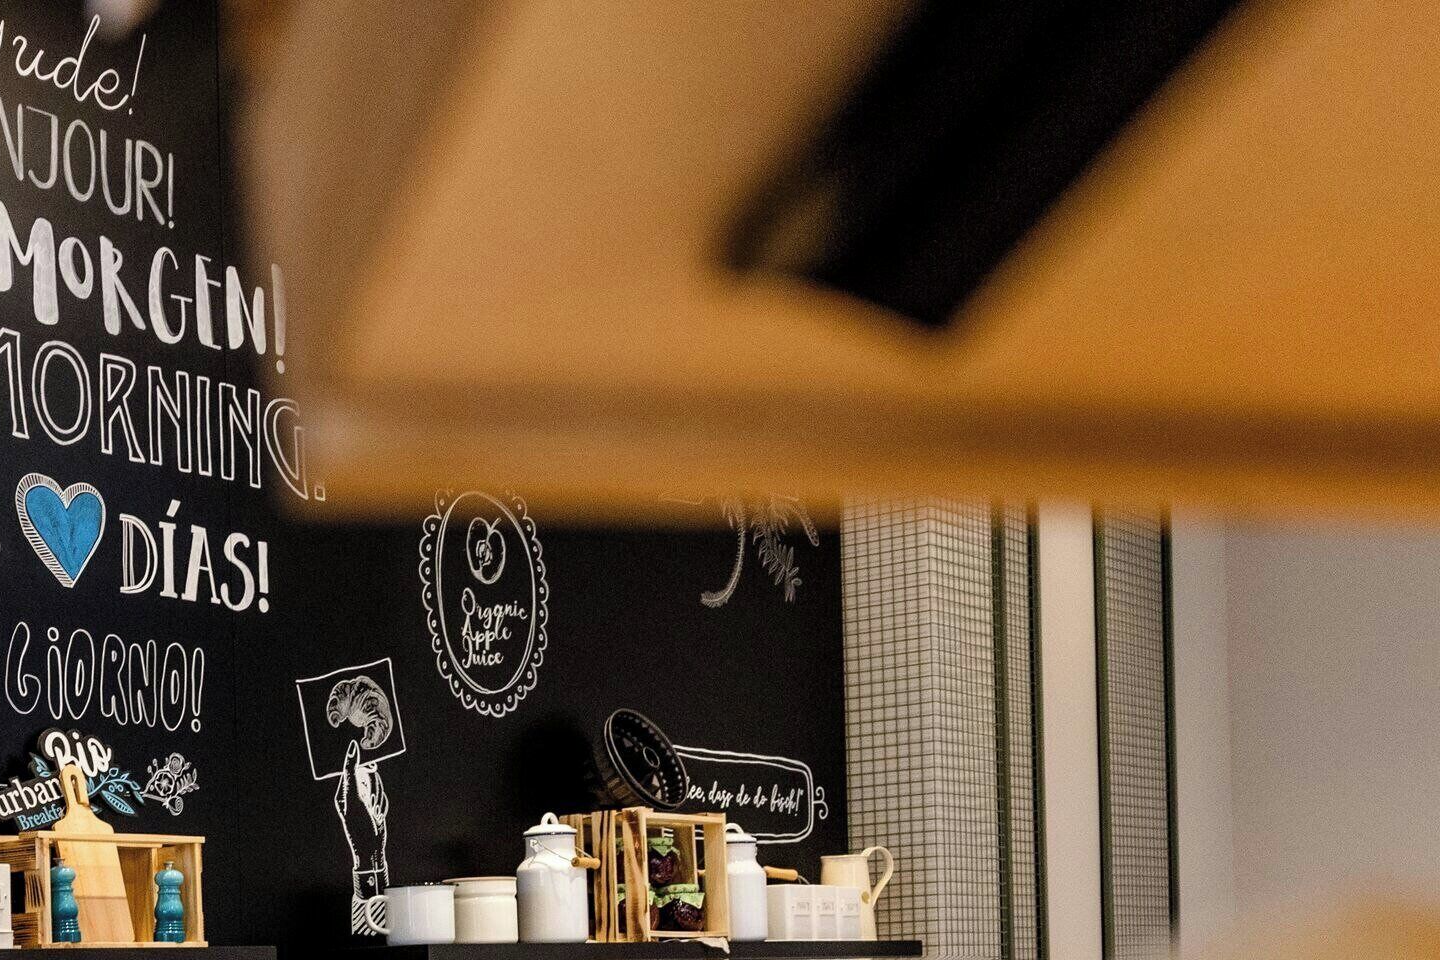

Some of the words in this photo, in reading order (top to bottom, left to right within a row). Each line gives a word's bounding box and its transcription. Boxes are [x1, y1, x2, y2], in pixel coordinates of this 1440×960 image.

[118, 499, 271, 613] DÍAS!
[461, 587, 528, 629] Organic
[461, 614, 512, 651] Apple
[462, 635, 504, 669] Juice
[44, 730, 112, 777] Bio
[17, 803, 65, 831] Breakfa
